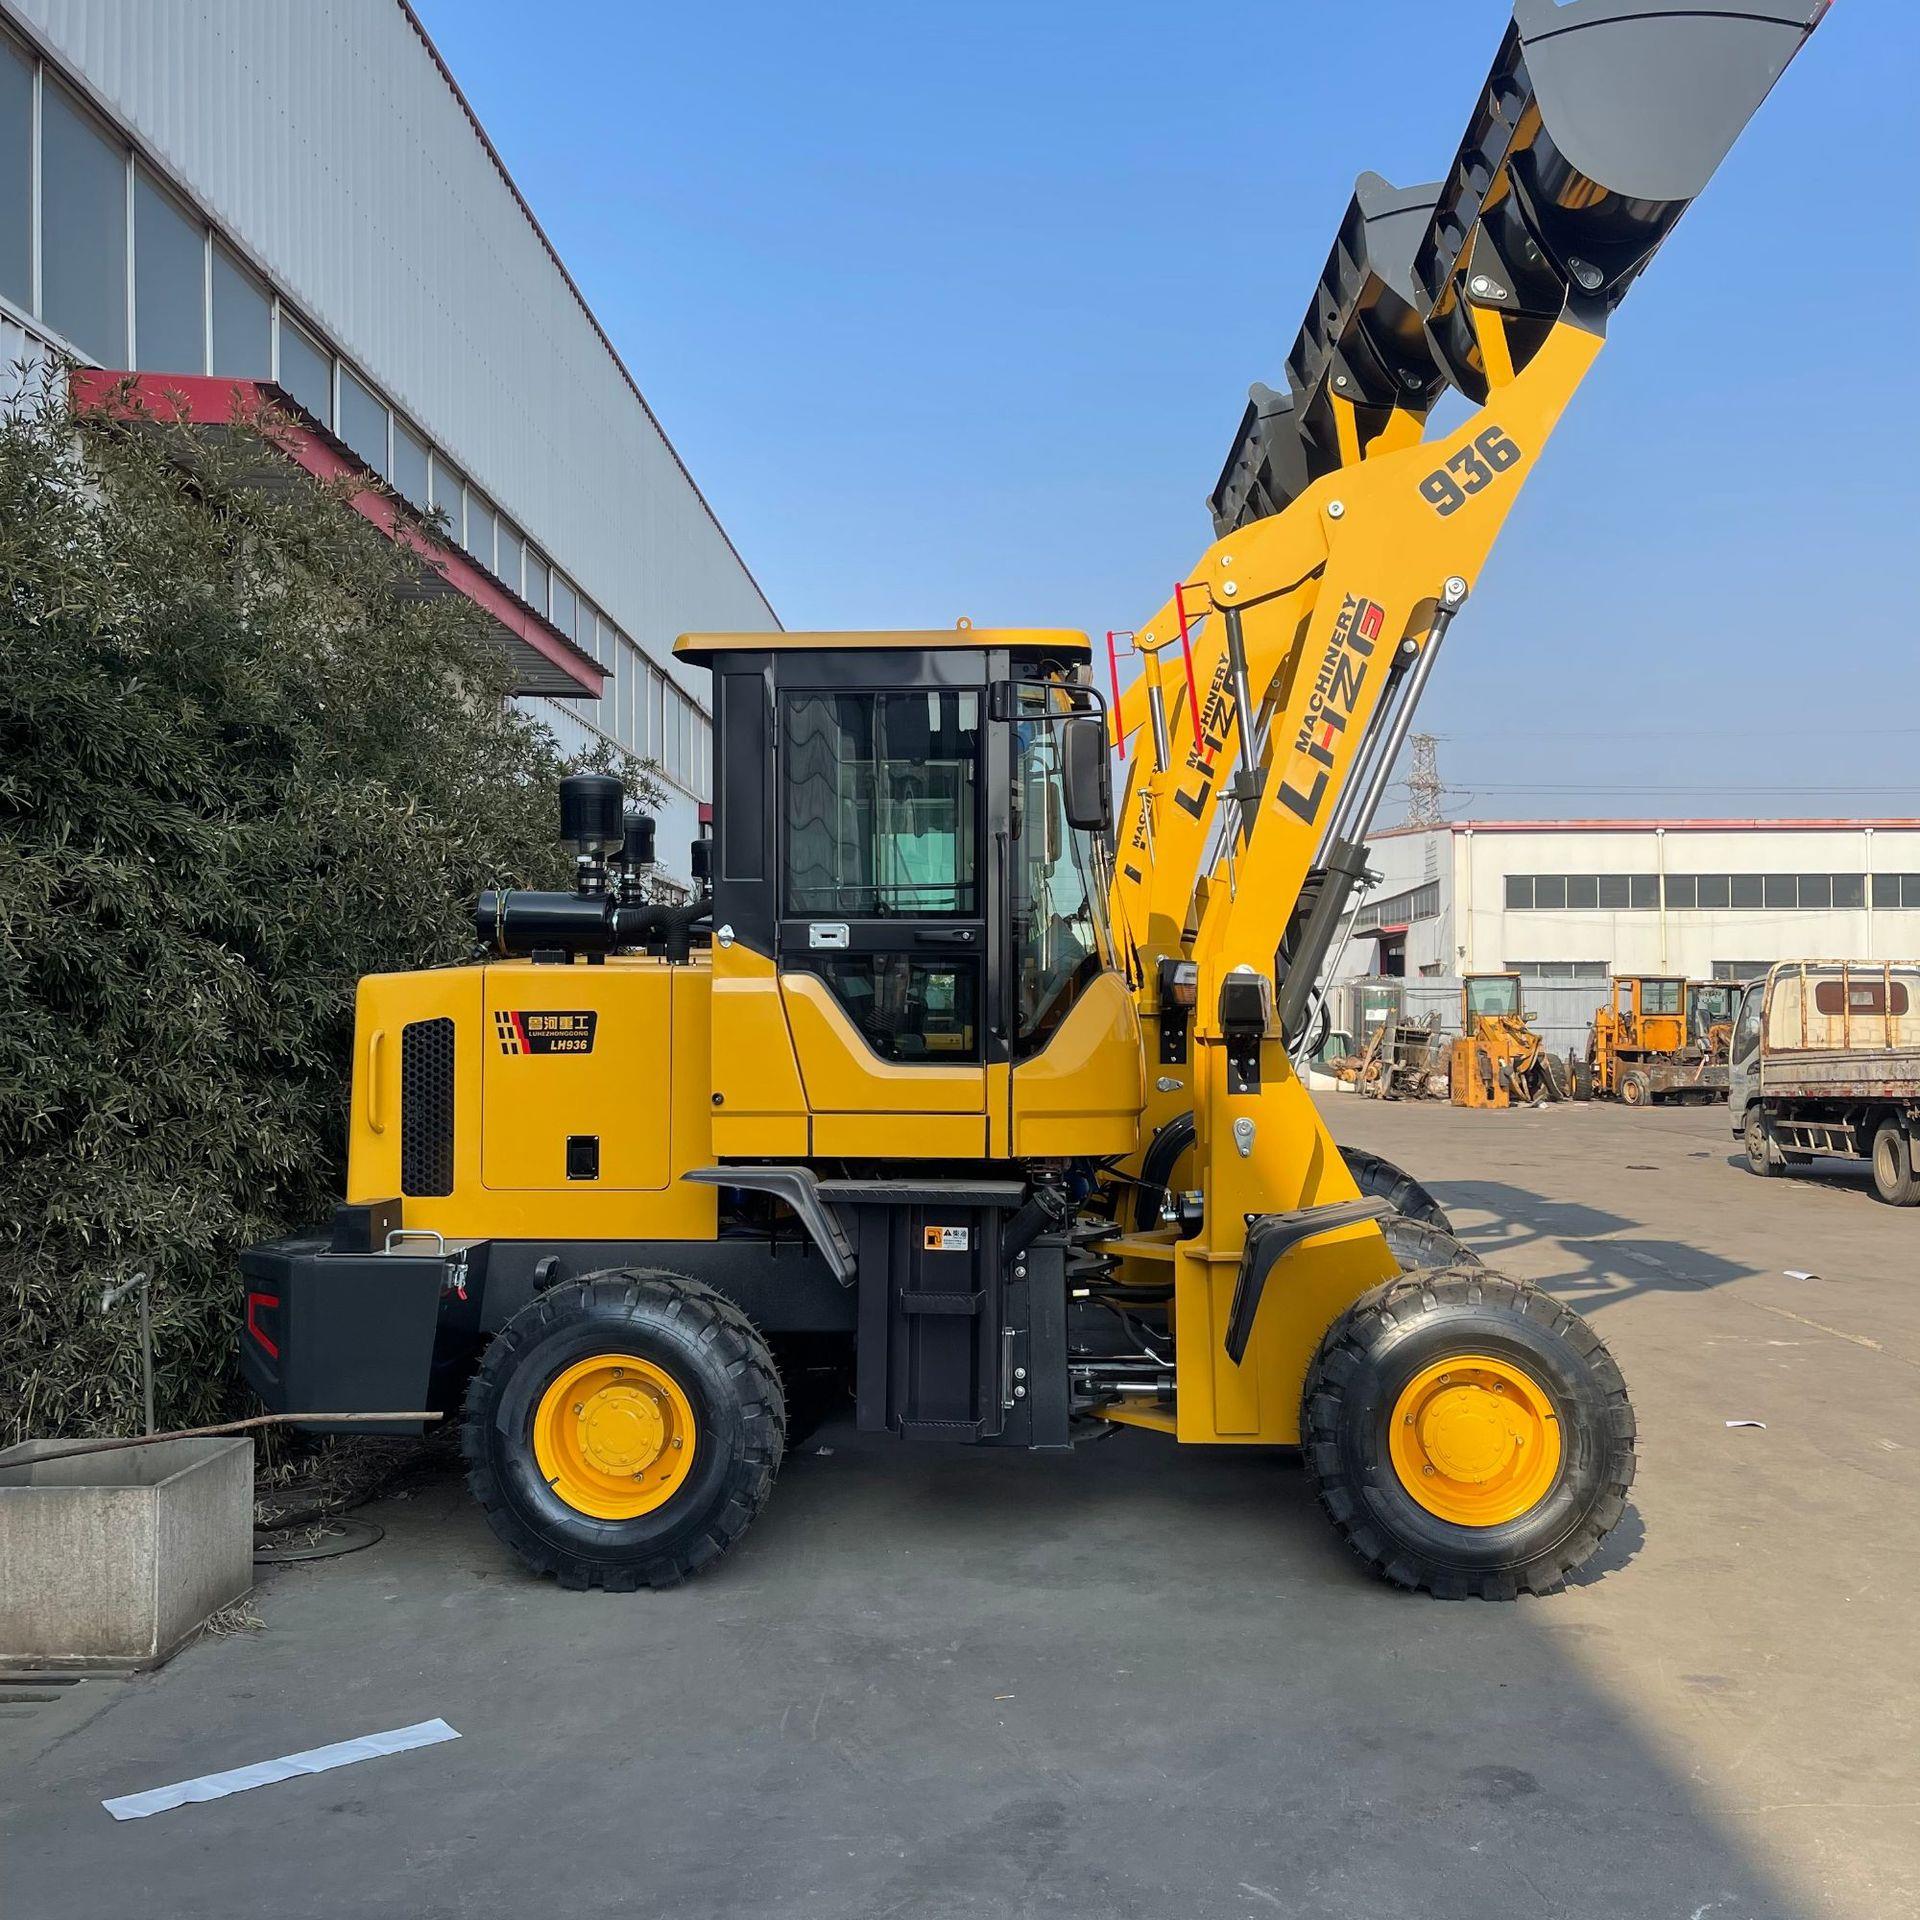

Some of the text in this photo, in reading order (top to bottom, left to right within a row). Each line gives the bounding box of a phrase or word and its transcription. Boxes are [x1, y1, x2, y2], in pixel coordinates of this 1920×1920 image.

[1419, 425, 1521, 516] 936
[1186, 651, 1229, 769] MHINERY
[1295, 592, 1357, 754] MACHINERY
[550, 1040, 588, 1050] LH936
